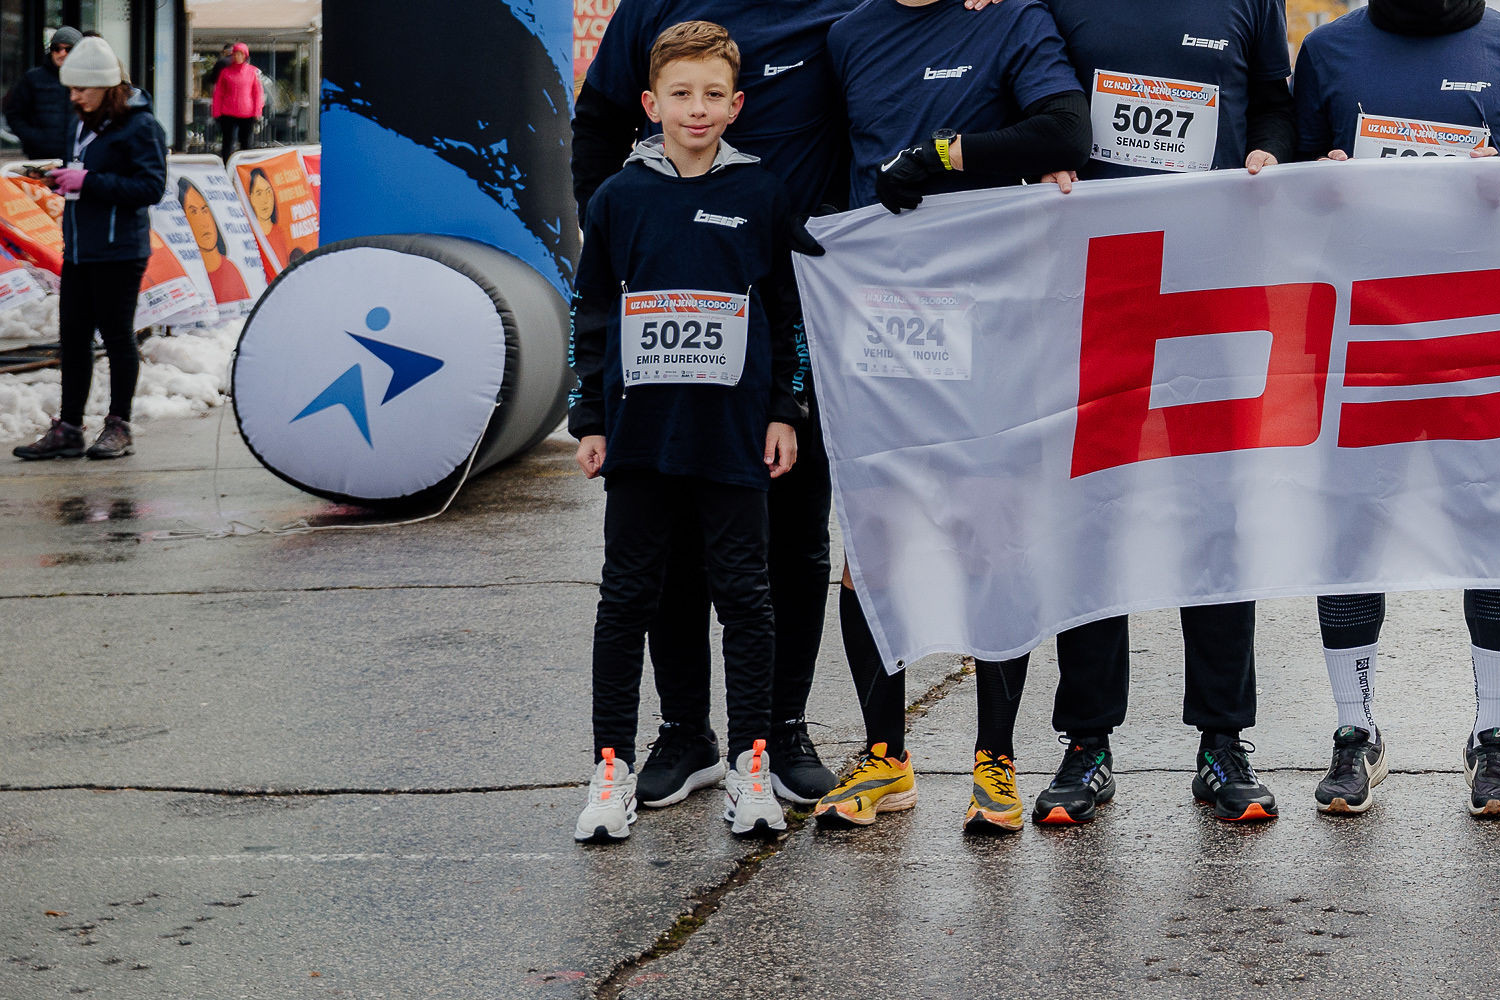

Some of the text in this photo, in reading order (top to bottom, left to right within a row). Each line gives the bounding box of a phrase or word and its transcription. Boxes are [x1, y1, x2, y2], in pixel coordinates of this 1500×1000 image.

[1103, 80, 1114, 89] UZ
[1114, 81, 1131, 91] NJU
[1171, 88, 1209, 100] SLOBODU
[1112, 103, 1195, 139] 5027
[1368, 124, 1379, 133] UZ
[1380, 125, 1397, 135] NJU
[1438, 131, 1477, 144] SLOBODU
[1116, 136, 1186, 154] SENAD ŠEHIĆ
[630, 301, 641, 310] UZ
[641, 299, 657, 309] NJU
[698, 299, 738, 311] SLOBODU
[640, 320, 724, 351] 5025
[866, 315, 946, 347] 5024
[636, 353, 727, 366] EMIR BUREKOVIĆ
[912, 349, 950, 361] INOVIĆ
